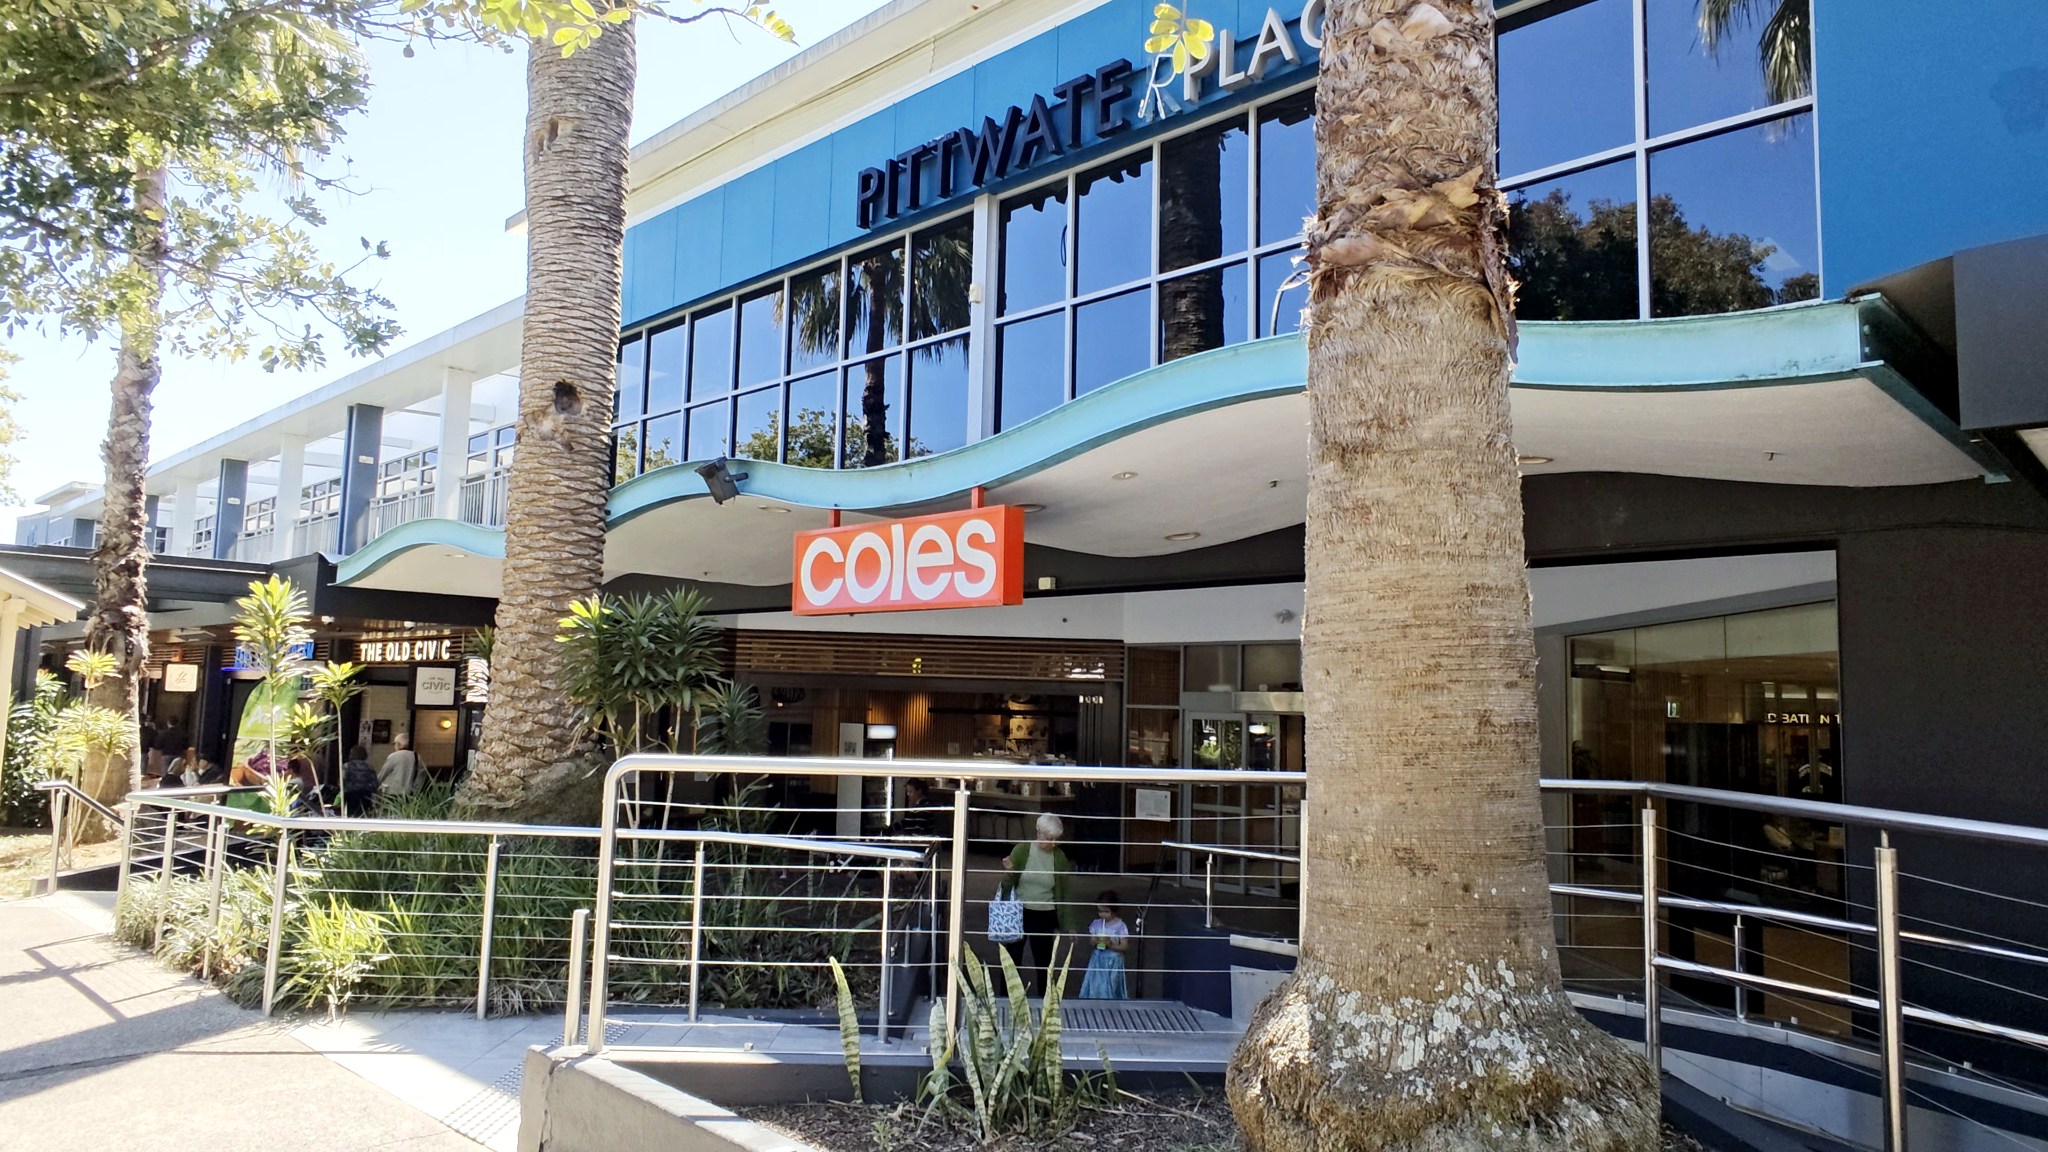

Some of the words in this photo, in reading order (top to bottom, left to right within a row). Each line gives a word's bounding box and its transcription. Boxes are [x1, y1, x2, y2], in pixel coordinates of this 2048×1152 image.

[1183, 0, 1325, 101] PLAC
[801, 519, 996, 606] coles
[360, 643, 382, 661] THE
[386, 641, 410, 661] OLD
[414, 639, 451, 661] CIVIC
[422, 681, 451, 691] CIVIC
